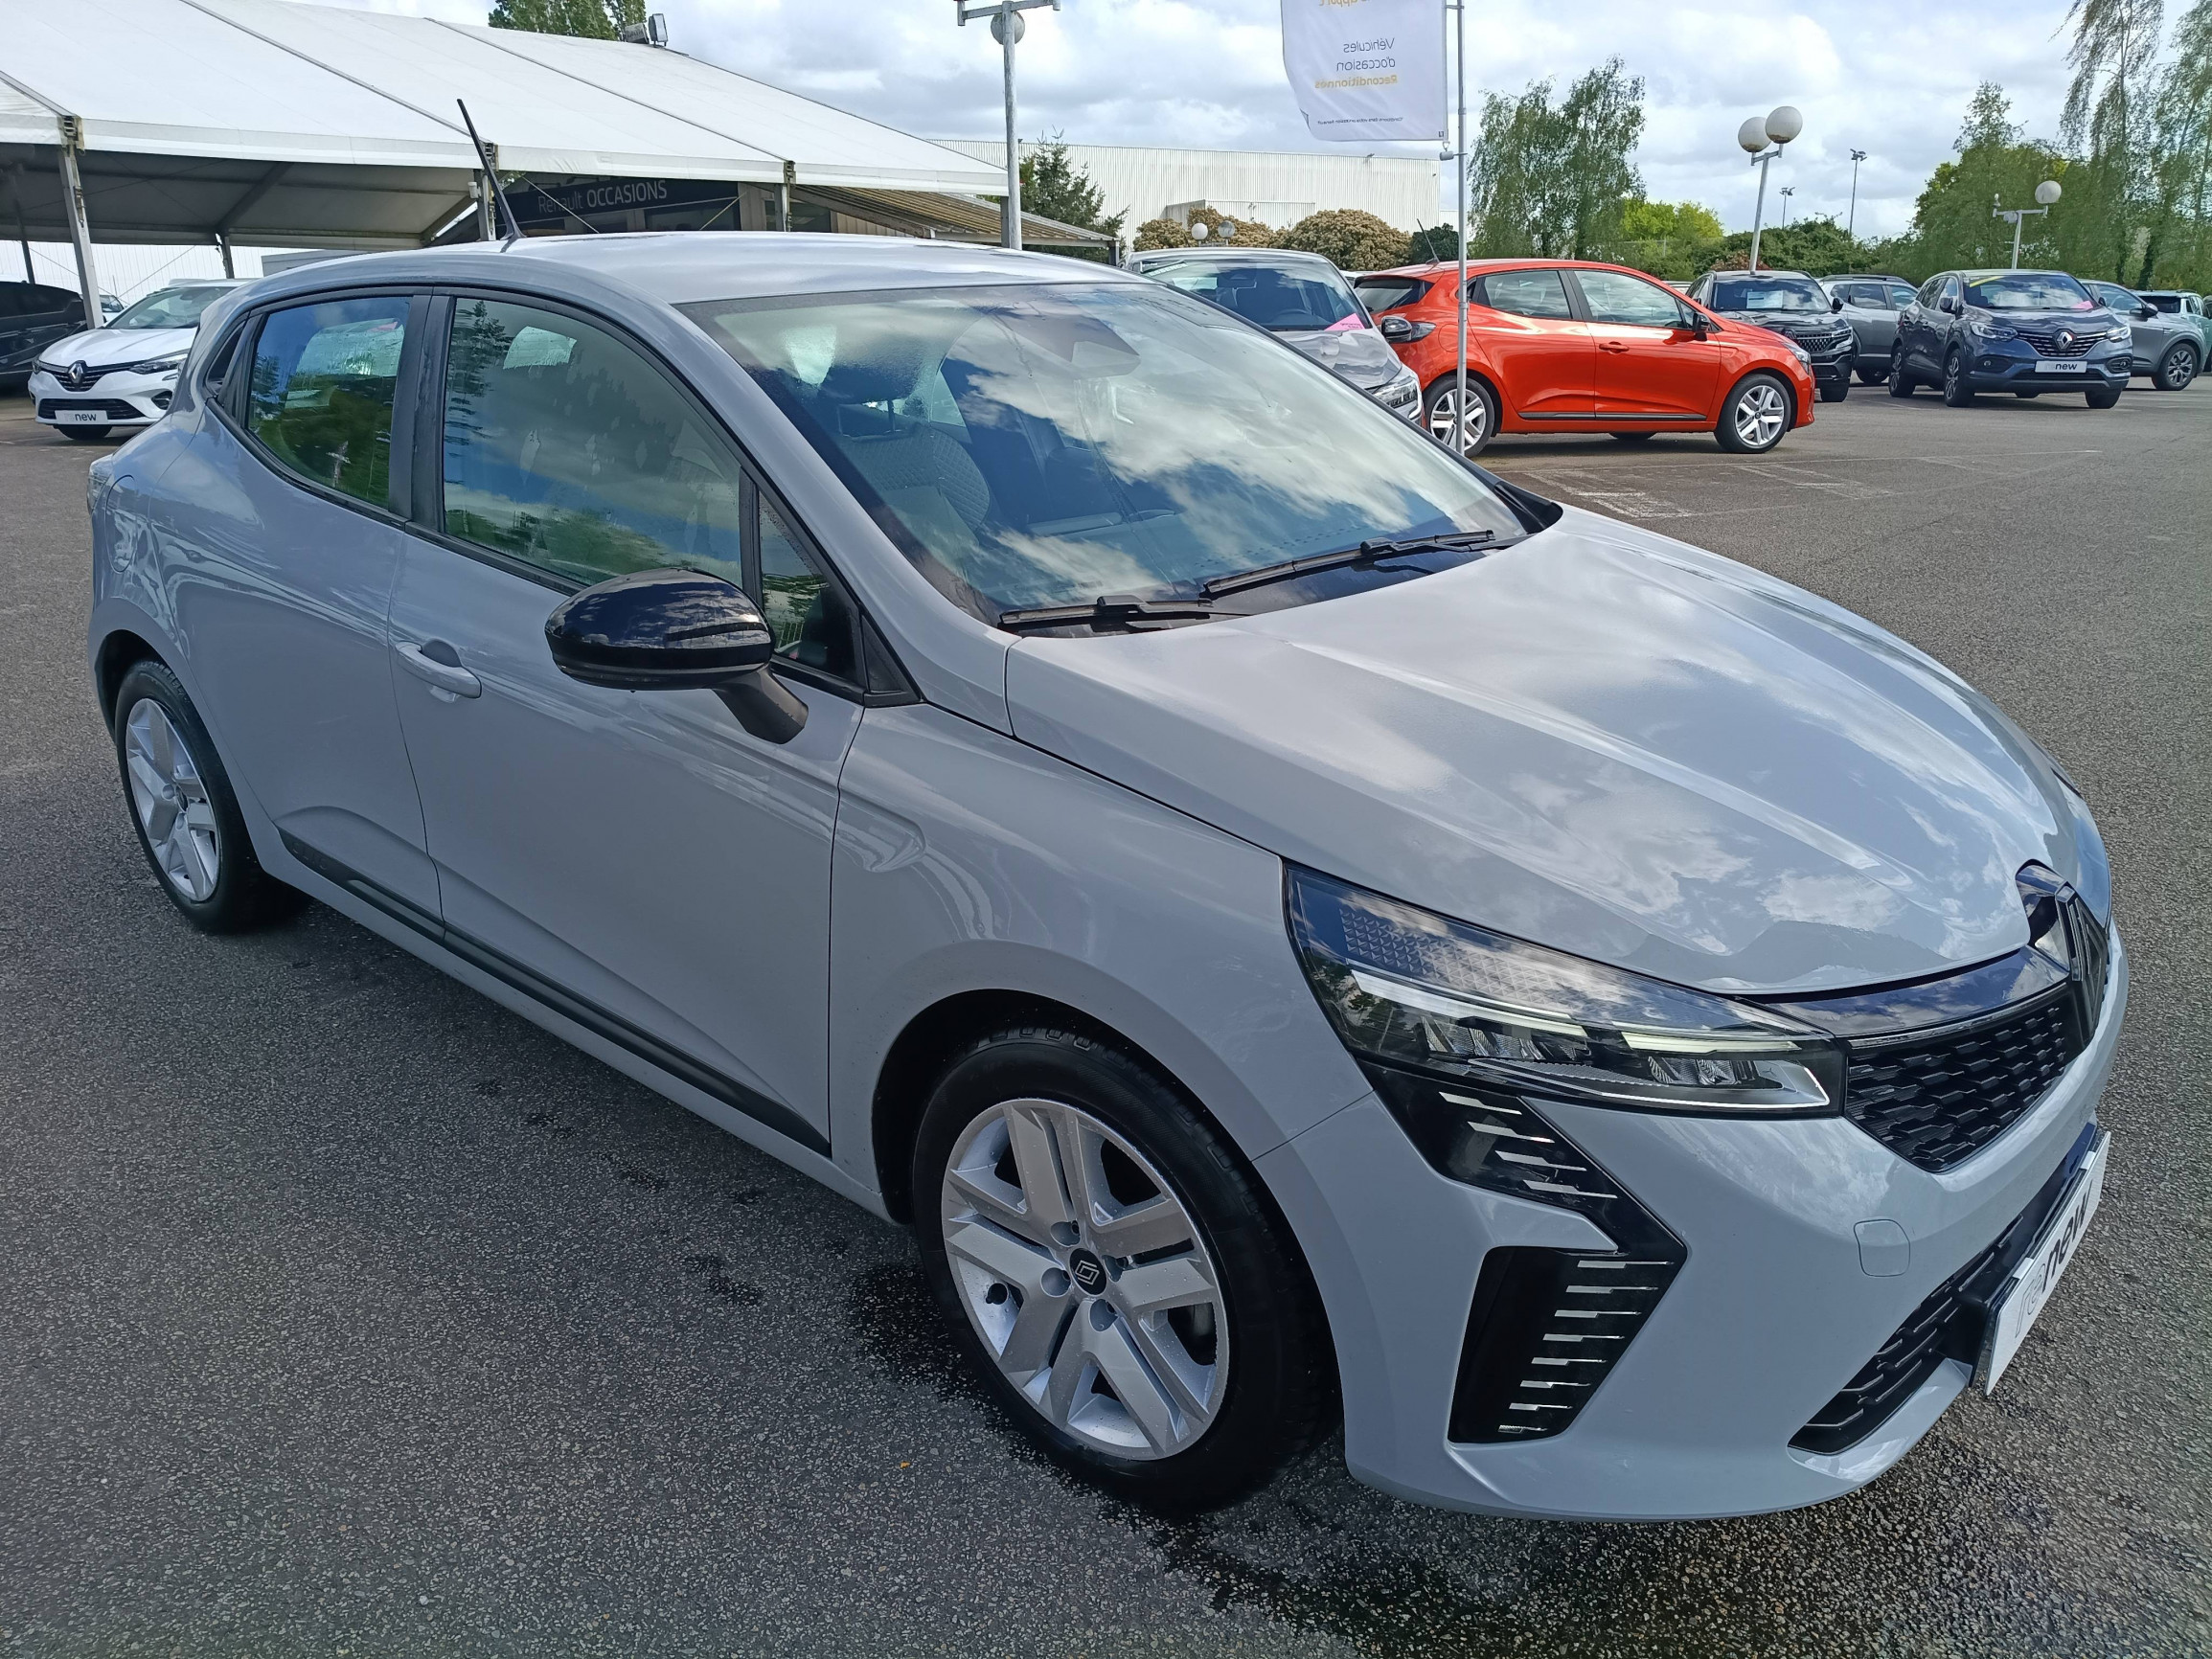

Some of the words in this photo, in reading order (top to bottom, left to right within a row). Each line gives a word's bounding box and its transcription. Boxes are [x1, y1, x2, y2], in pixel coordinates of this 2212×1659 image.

[538, 191, 584, 214] Renault
[586, 180, 667, 208] OCCASIONS
[2015, 1179, 2093, 1339] renew
